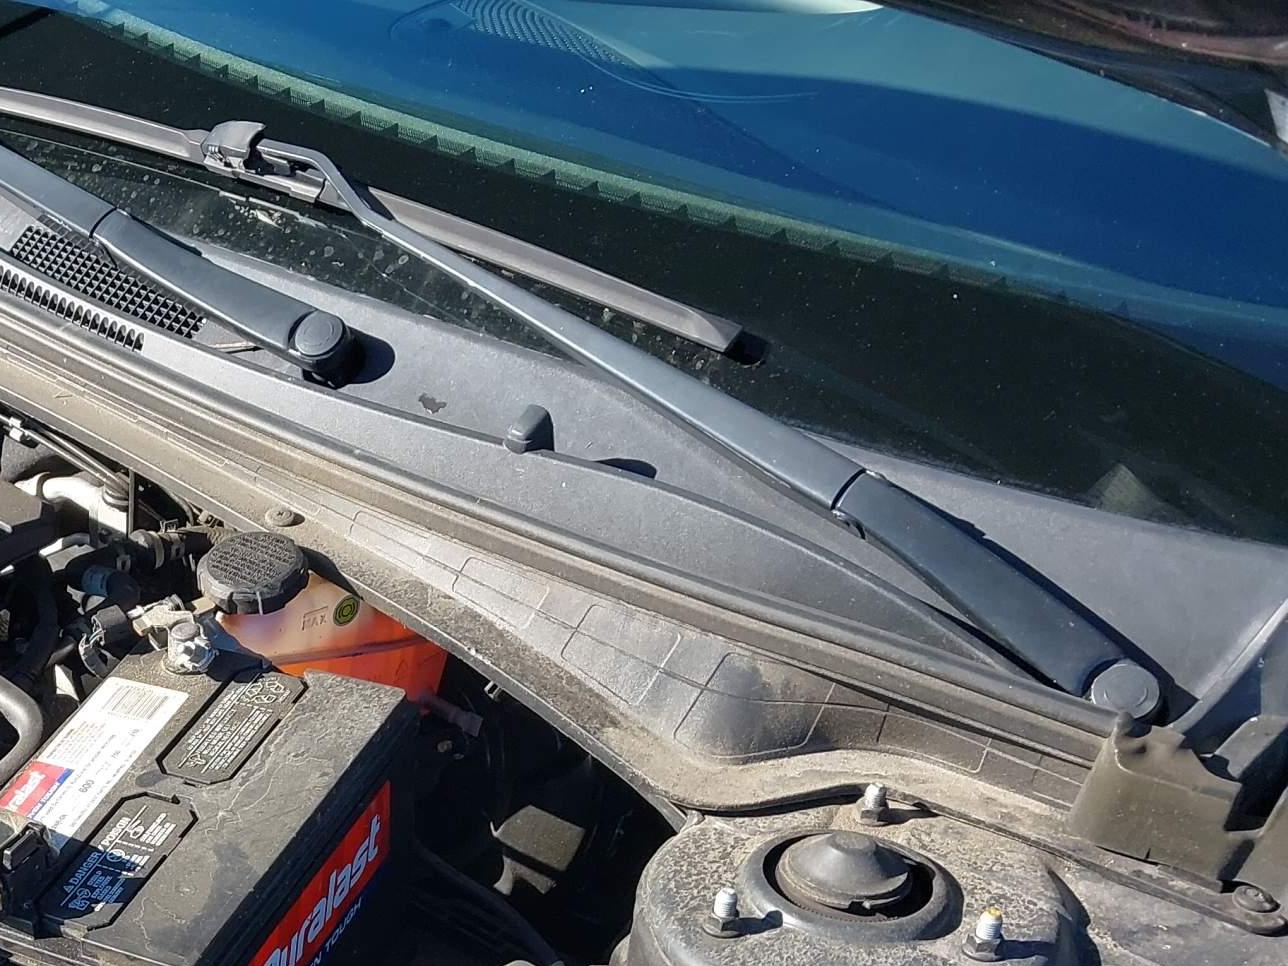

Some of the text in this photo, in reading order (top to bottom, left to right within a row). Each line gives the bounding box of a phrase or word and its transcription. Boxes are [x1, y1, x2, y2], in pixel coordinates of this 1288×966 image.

[70, 851, 102, 885] DANGER
[102, 816, 131, 847] POISON
[324, 896, 362, 952] TOUGH
